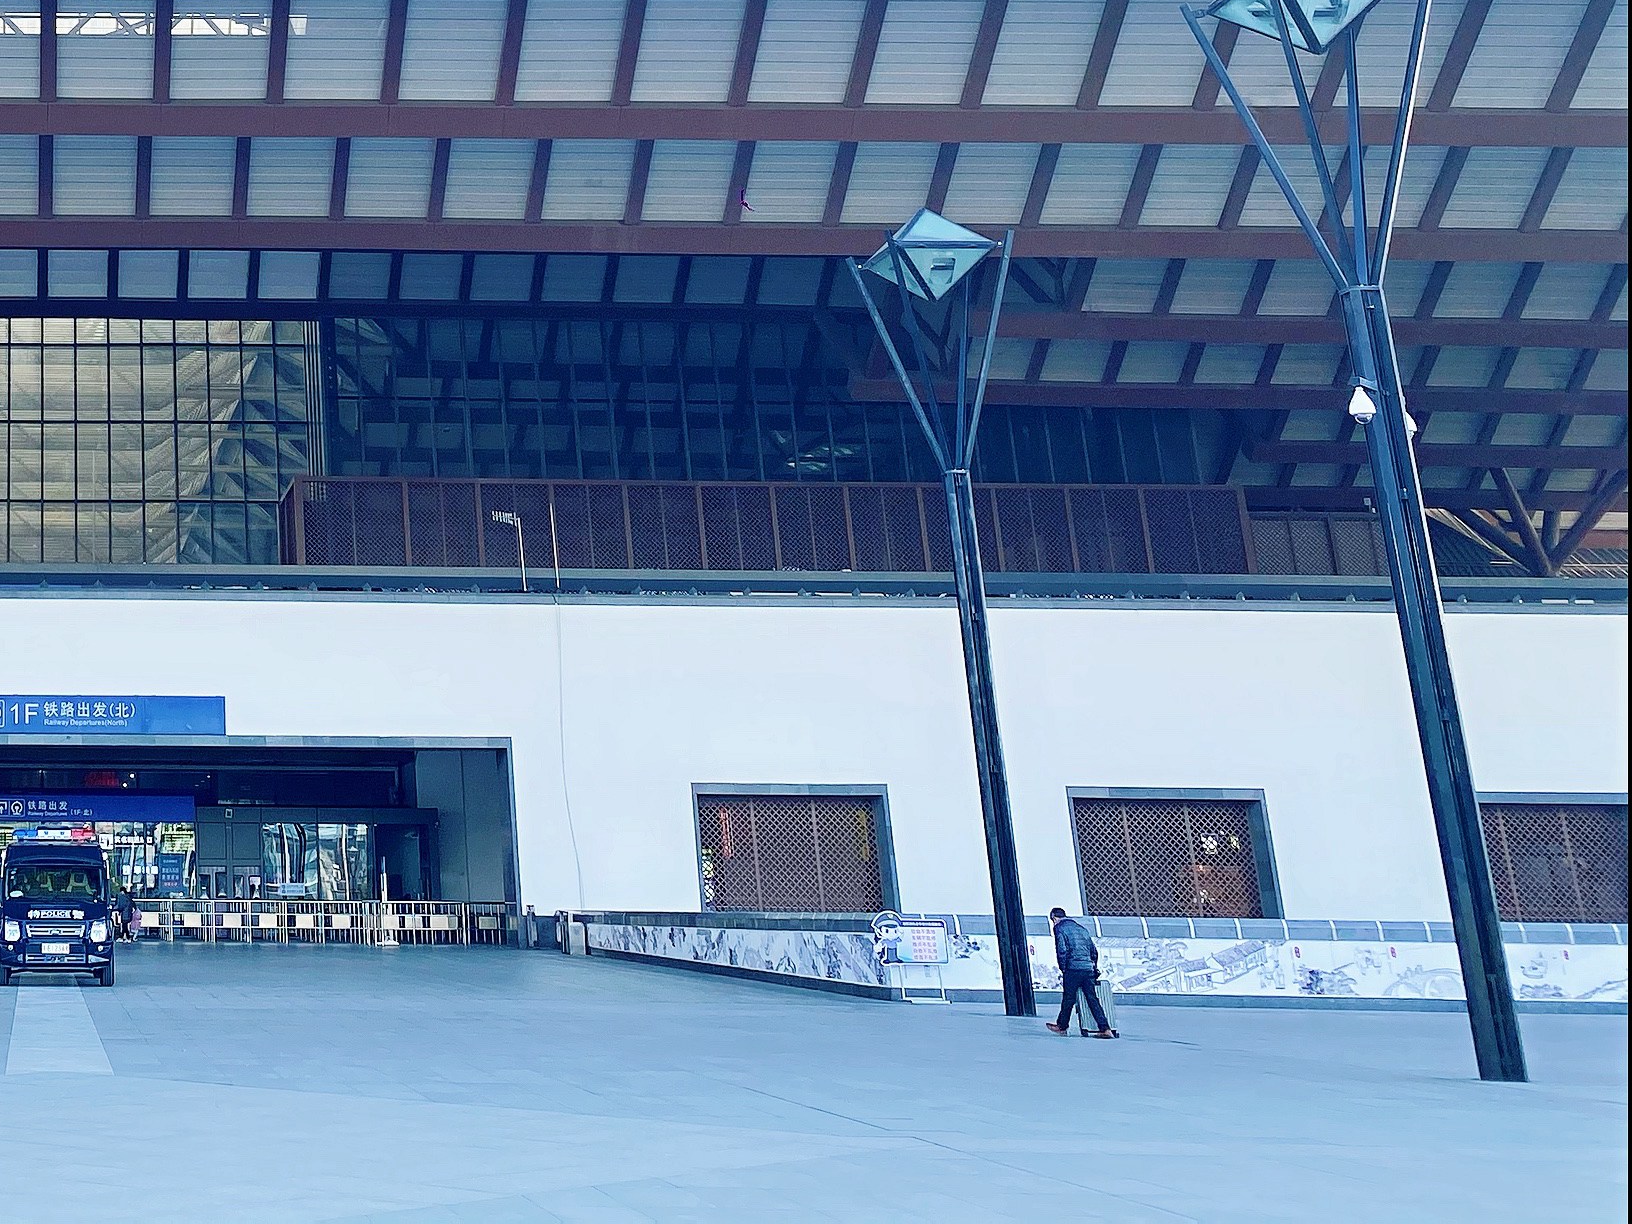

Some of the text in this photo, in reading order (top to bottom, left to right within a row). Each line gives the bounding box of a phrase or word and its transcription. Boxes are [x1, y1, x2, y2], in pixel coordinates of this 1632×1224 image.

[9, 702, 40, 725] 1F
[43, 700, 136, 719] 铁路出发(北)
[43, 718, 69, 727] Railway
[27, 800, 68, 811] 铁路出发
